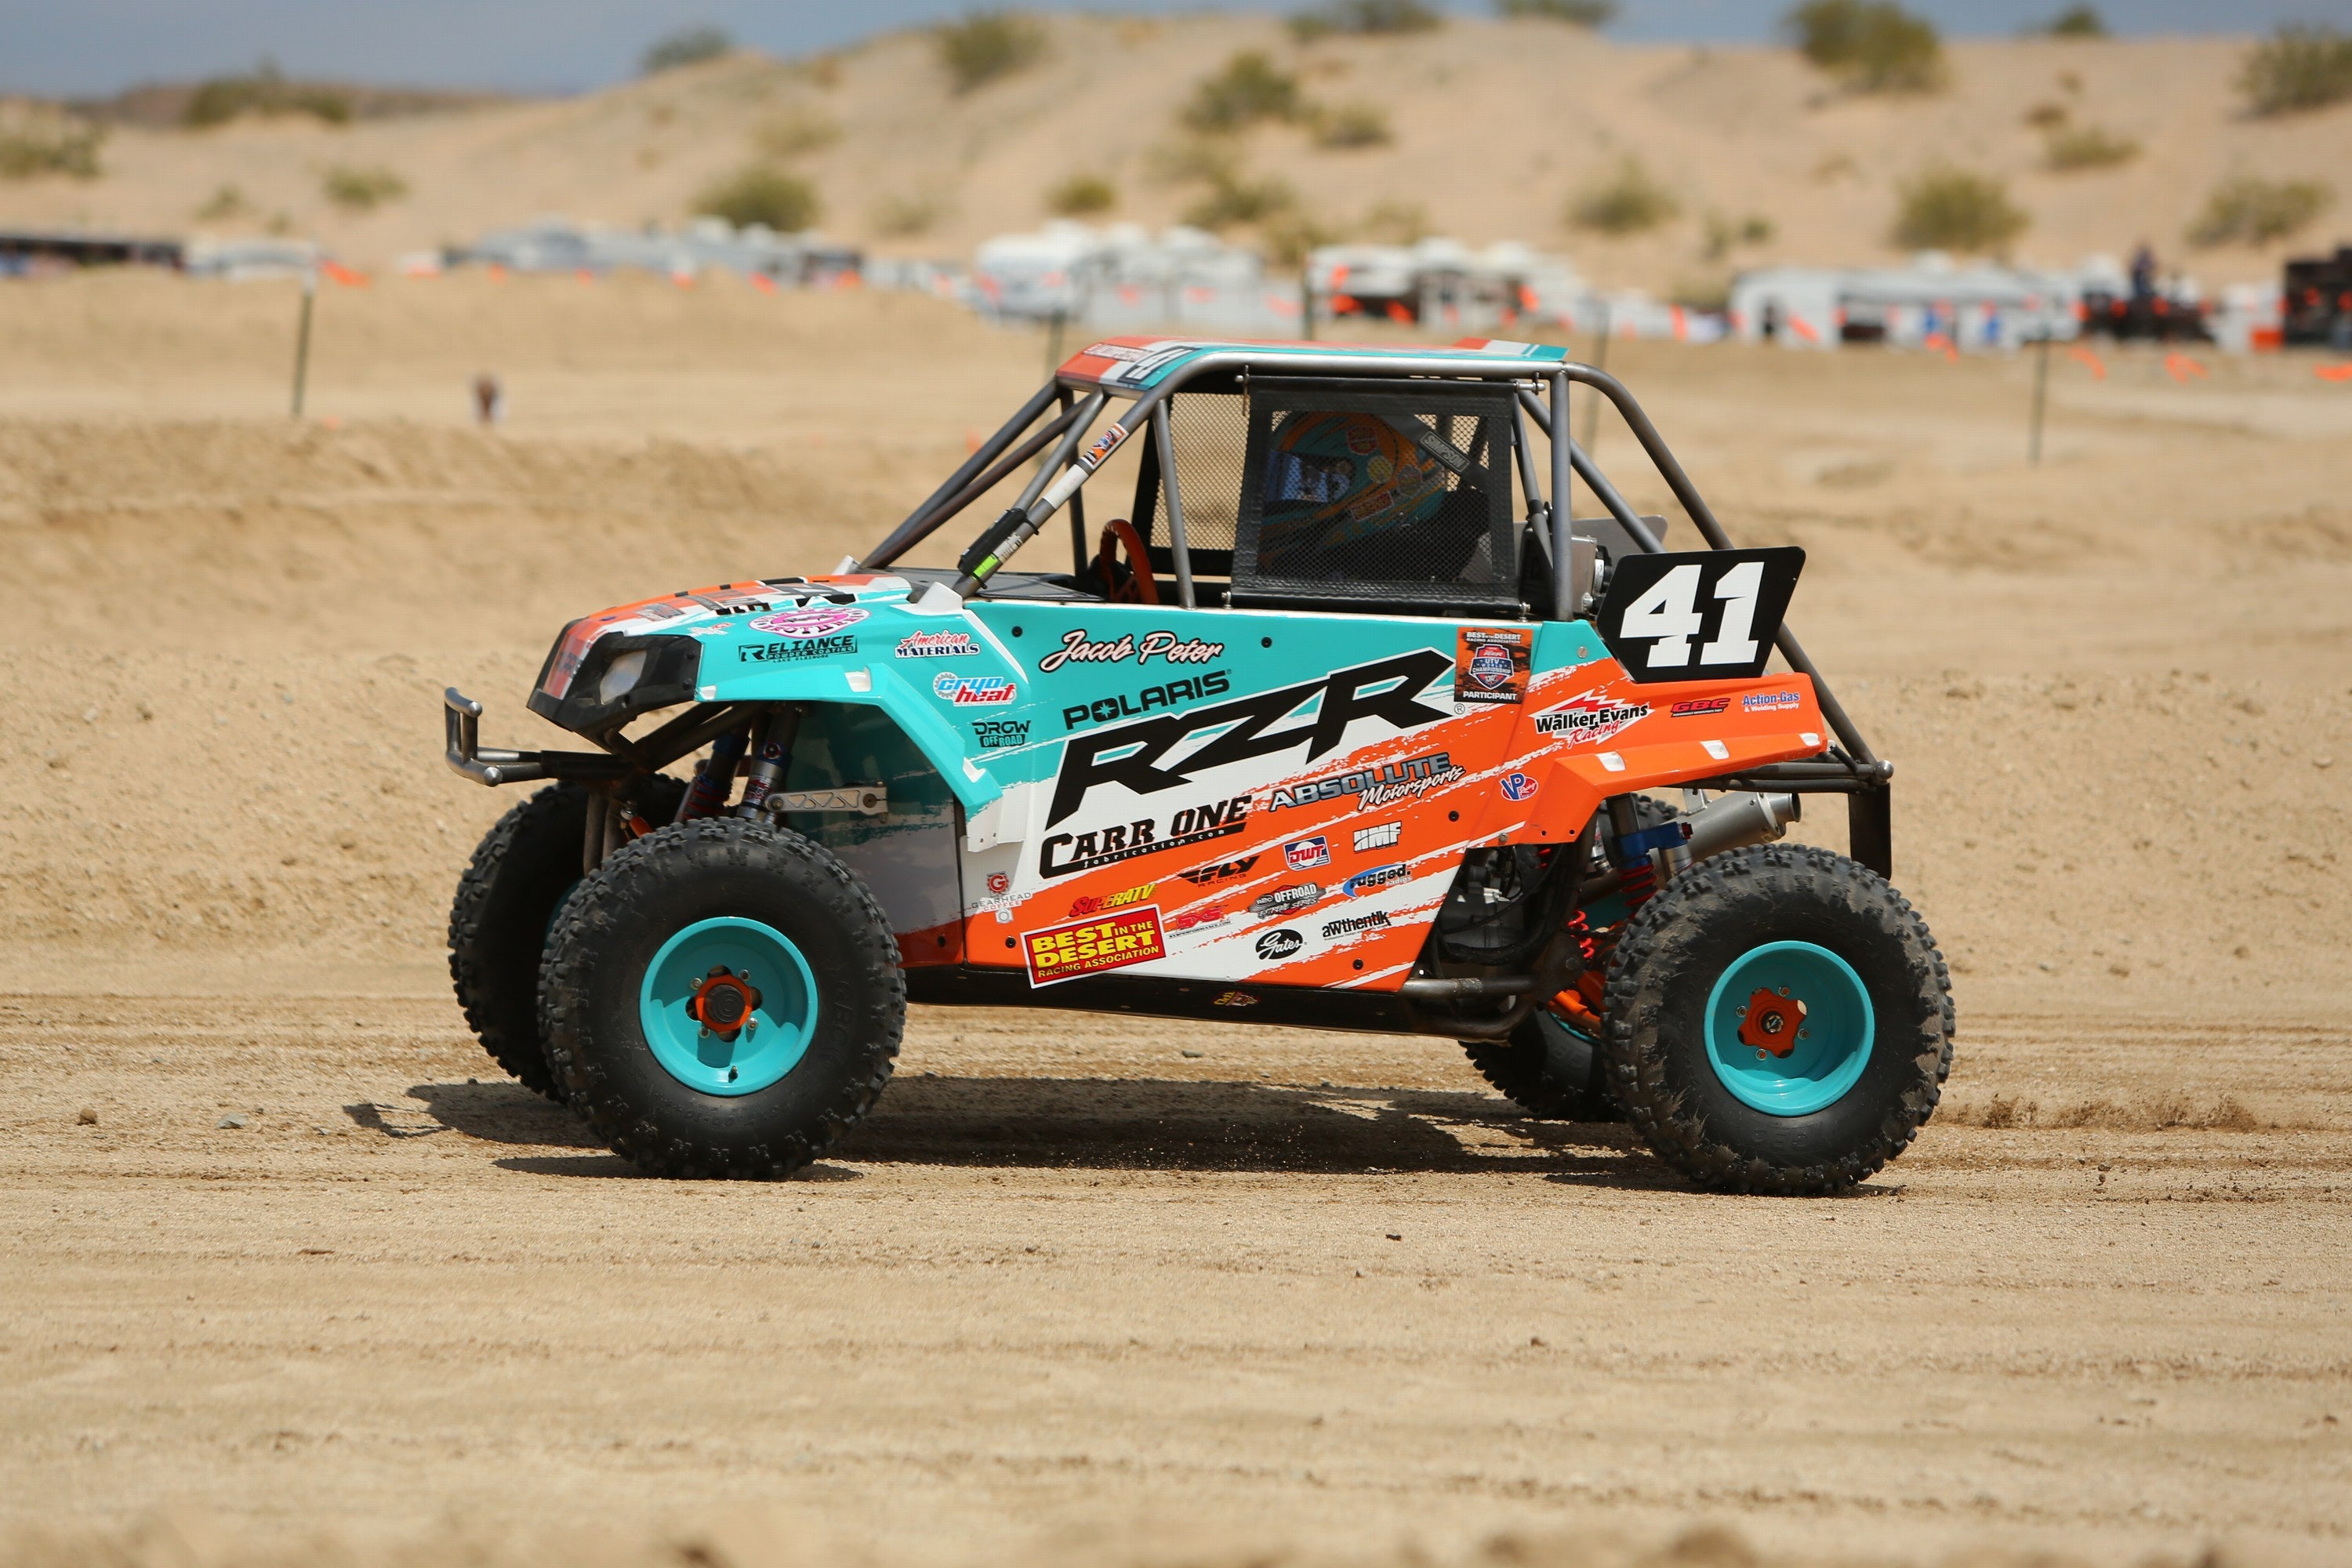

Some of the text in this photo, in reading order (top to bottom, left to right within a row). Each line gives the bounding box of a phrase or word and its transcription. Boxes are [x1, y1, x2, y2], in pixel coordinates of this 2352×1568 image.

[1424, 434, 1467, 469] SIMPSON
[1620, 561, 1765, 669] 41
[739, 635, 855, 662] RELIANCE
[896, 644, 979, 657] MATERIALS
[901, 631, 969, 648] American
[1040, 629, 1224, 672] Jacob Peter
[938, 677, 1004, 696] cryo
[954, 684, 1016, 702] heat
[1062, 670, 1230, 730] POLARIS
[1535, 704, 1649, 733] Walker Evans
[1671, 698, 1731, 713] GBC
[1044, 647, 1456, 832] RZR
[1567, 720, 1621, 749] Racing
[1269, 752, 1451, 812] ABSOLUTE
[1357, 765, 1465, 811] Motorsports
[1501, 773, 1526, 800] VP
[1039, 794, 1253, 880] CARR ONE
[1289, 844, 1326, 863] DWT
[1198, 873, 1247, 887] RACING
[1273, 884, 1318, 903] OFFROAD
[971, 891, 1033, 909] GEARHEAD
[983, 900, 1022, 912] COFFEE
[1031, 920, 1154, 953] BEST IN THE
[1035, 930, 1156, 969] DESERT
[1258, 931, 1303, 960] Gates
[1038, 945, 1160, 978] RACING ASSOCIATION
